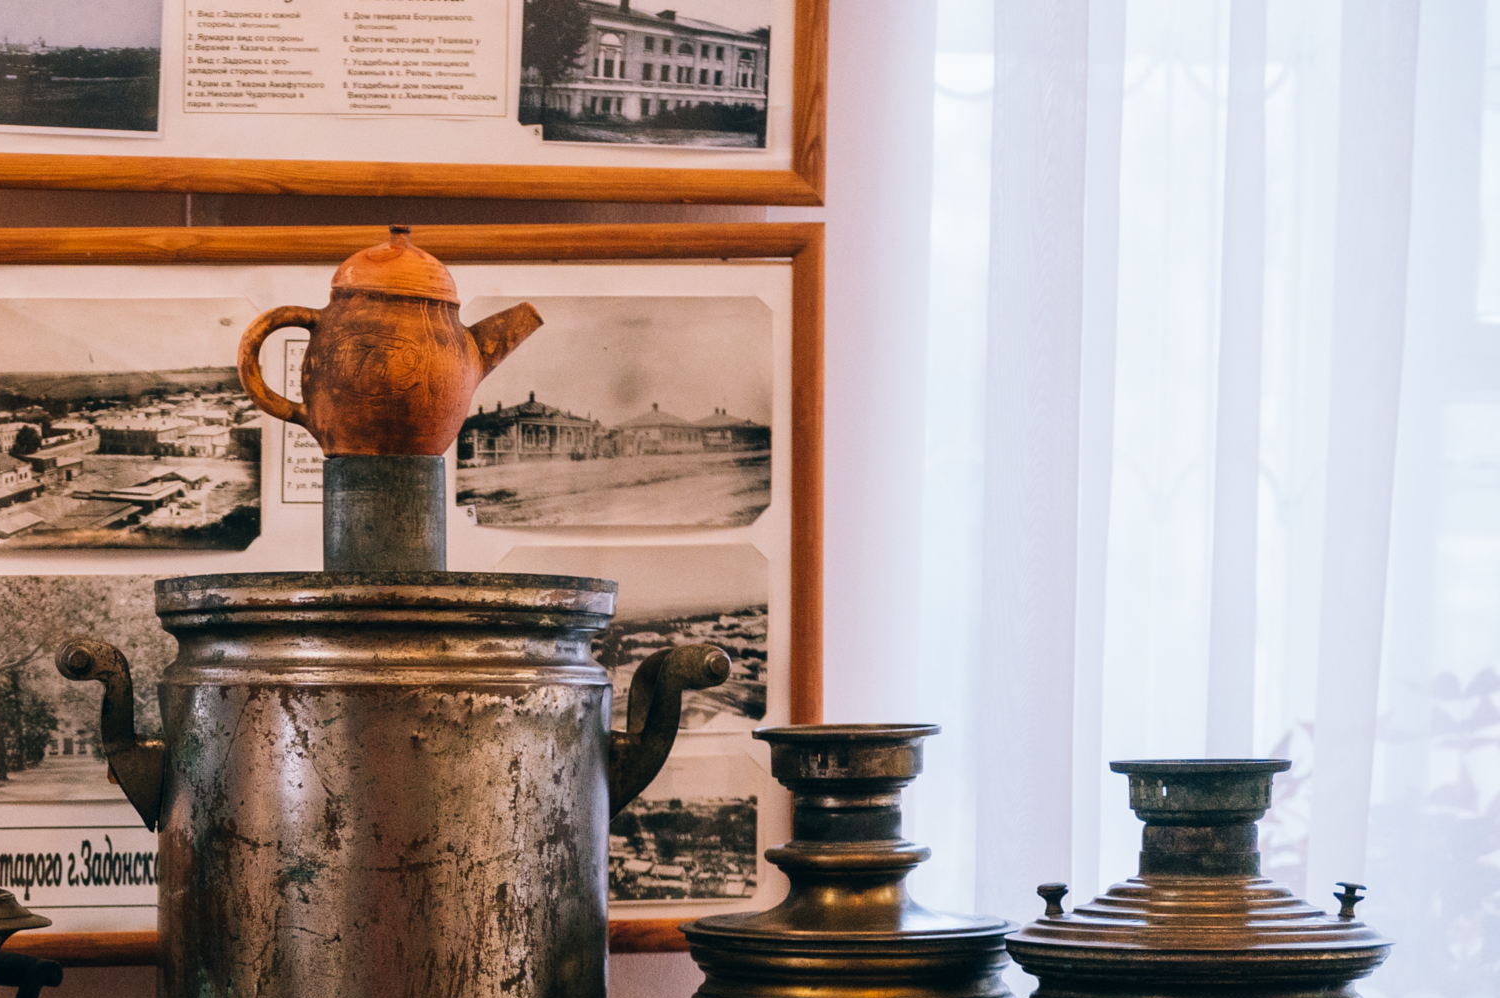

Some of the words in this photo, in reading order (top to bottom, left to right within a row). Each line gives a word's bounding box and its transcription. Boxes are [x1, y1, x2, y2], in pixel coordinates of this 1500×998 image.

[197, 10, 215, 19] Вид
[352, 12, 371, 20] Дом
[197, 34, 234, 42] Ярмарка
[411, 37, 435, 45] речку
[438, 36, 473, 44] Тешевка
[475, 38, 481, 46] у
[197, 57, 215, 65] Вид
[352, 59, 400, 67] Усадебный
[197, 80, 219, 88] Храм
[236, 80, 266, 88] Тихона
[246, 91, 297, 99] Чудотворца
[451, 92, 498, 101] Городском
[467, 507, 474, 517] 5
[67, 834, 158, 887] г.Задонск
